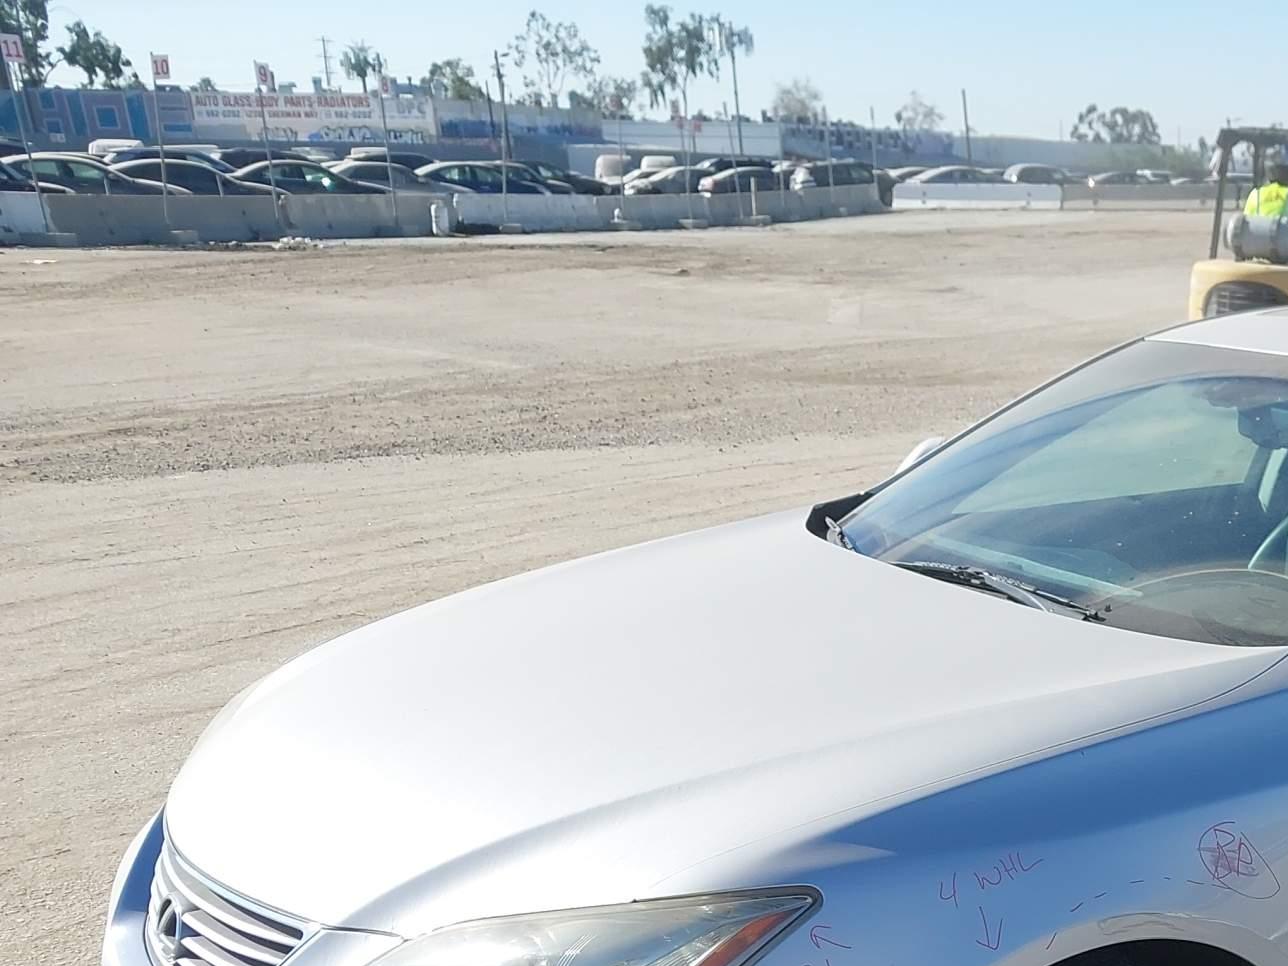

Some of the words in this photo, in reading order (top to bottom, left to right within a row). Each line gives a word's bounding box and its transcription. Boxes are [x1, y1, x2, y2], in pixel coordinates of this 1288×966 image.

[2, 39, 23, 59] 11
[153, 58, 170, 76] 10
[257, 65, 268, 83] 9
[194, 95, 219, 107] AUTO
[222, 95, 252, 107] GLASS
[255, 95, 279, 107] BODY
[283, 95, 314, 108] PARTS
[317, 95, 370, 108] RADIATORS
[939, 871, 958, 909] 4
[973, 851, 1045, 890] WHL
